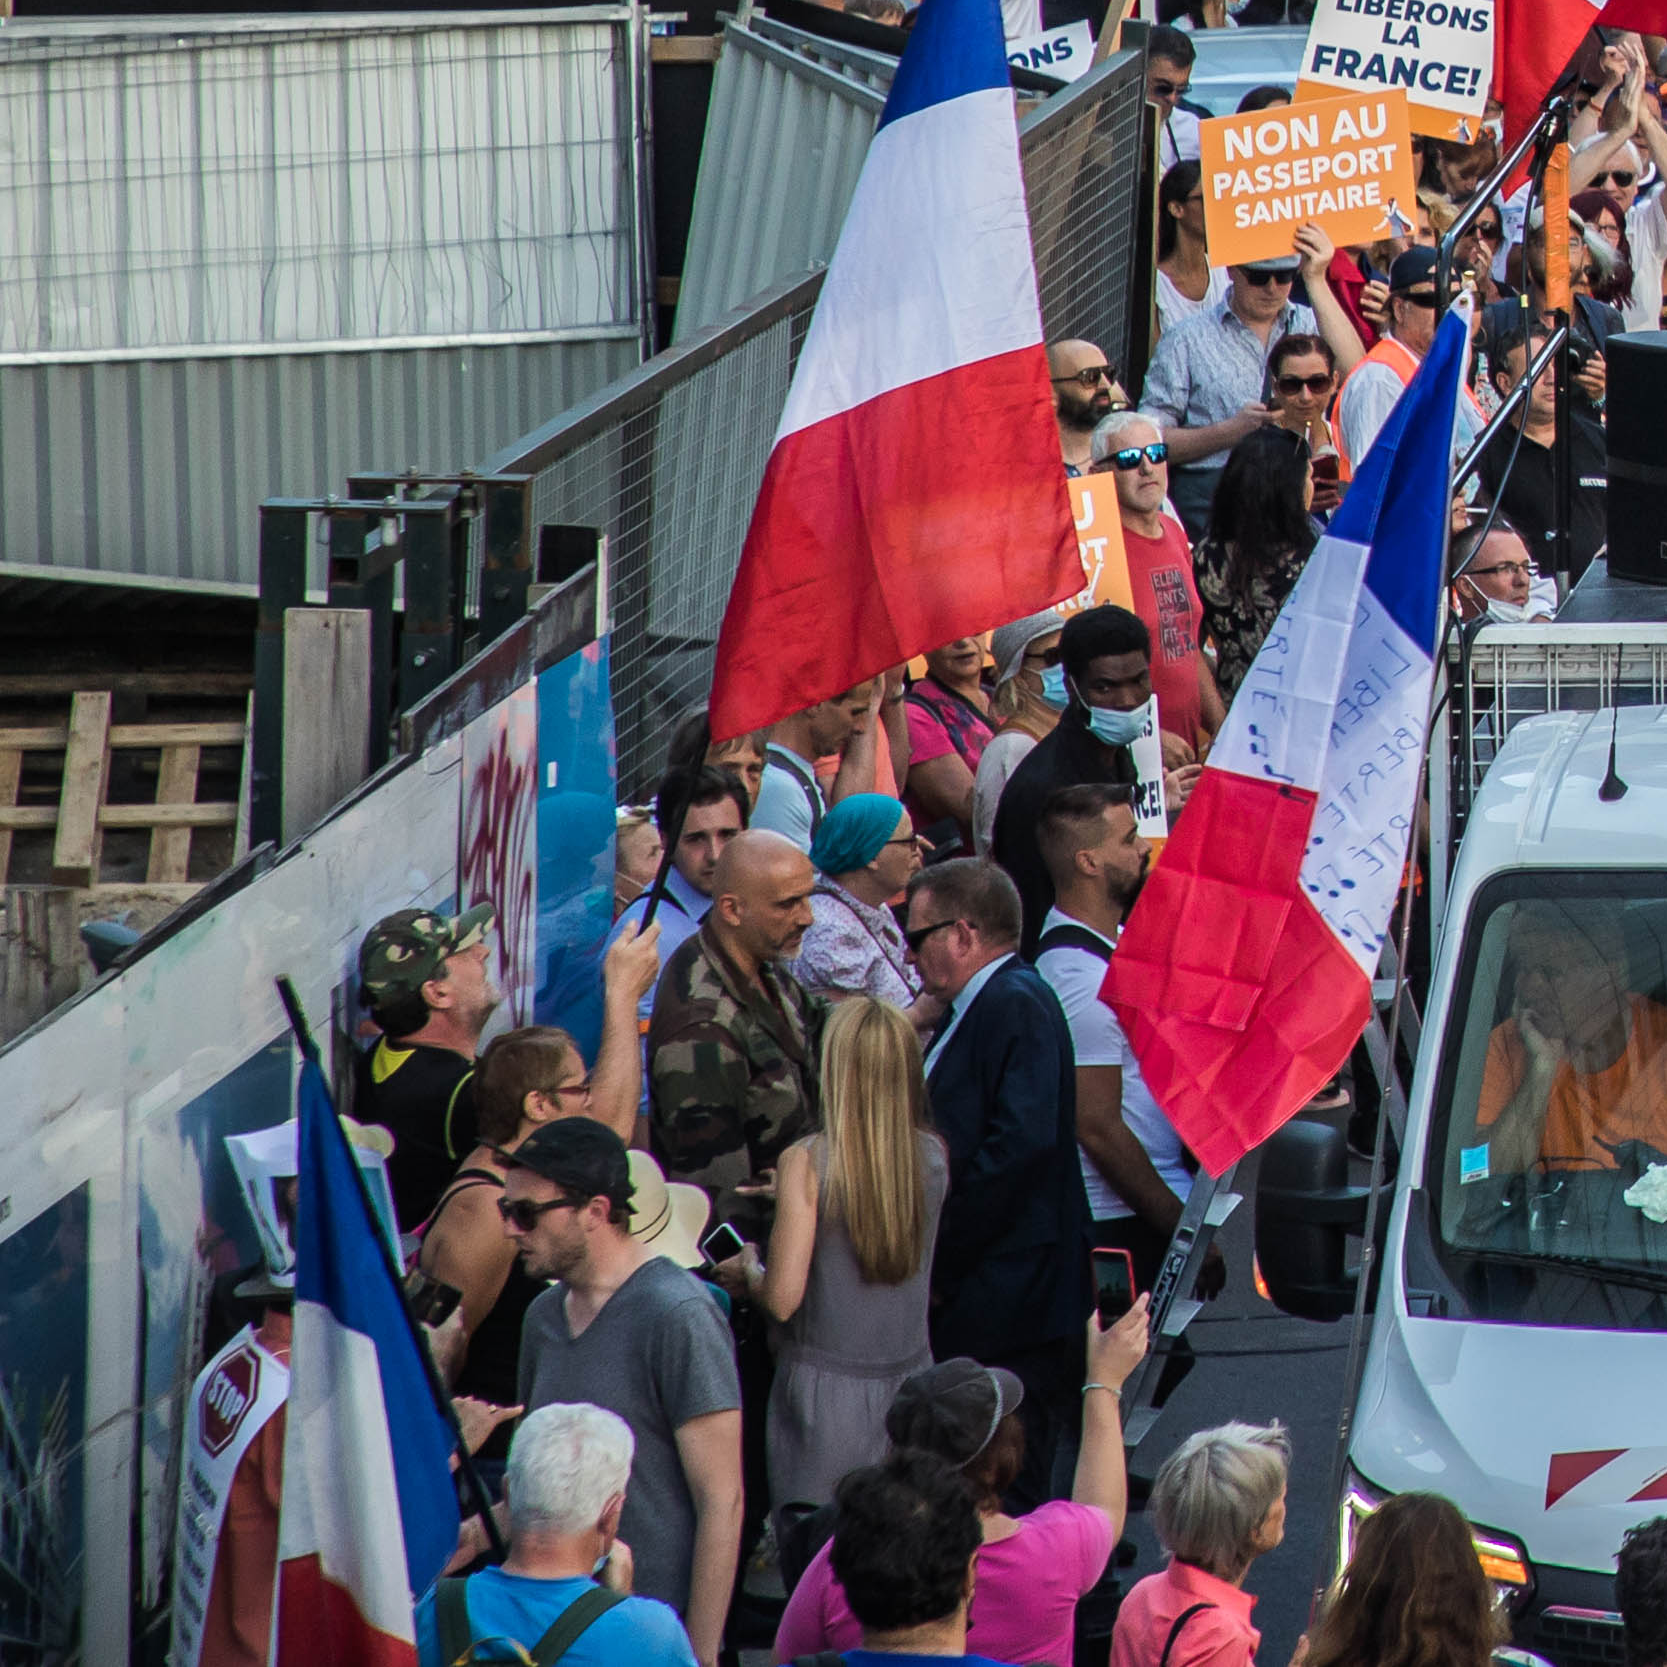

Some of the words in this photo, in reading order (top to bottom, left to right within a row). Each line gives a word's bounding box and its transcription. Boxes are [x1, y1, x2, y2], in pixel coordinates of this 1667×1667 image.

[1381, 21, 1421, 49] LA
[1310, 43, 1482, 98] FRANCE!
[1223, 113, 1320, 163] NON
[1330, 102, 1388, 145] AU
[1212, 143, 1398, 201] PASSEPORT
[1234, 181, 1382, 230] SANITAIRE
[207, 1371, 246, 1425] STOP
